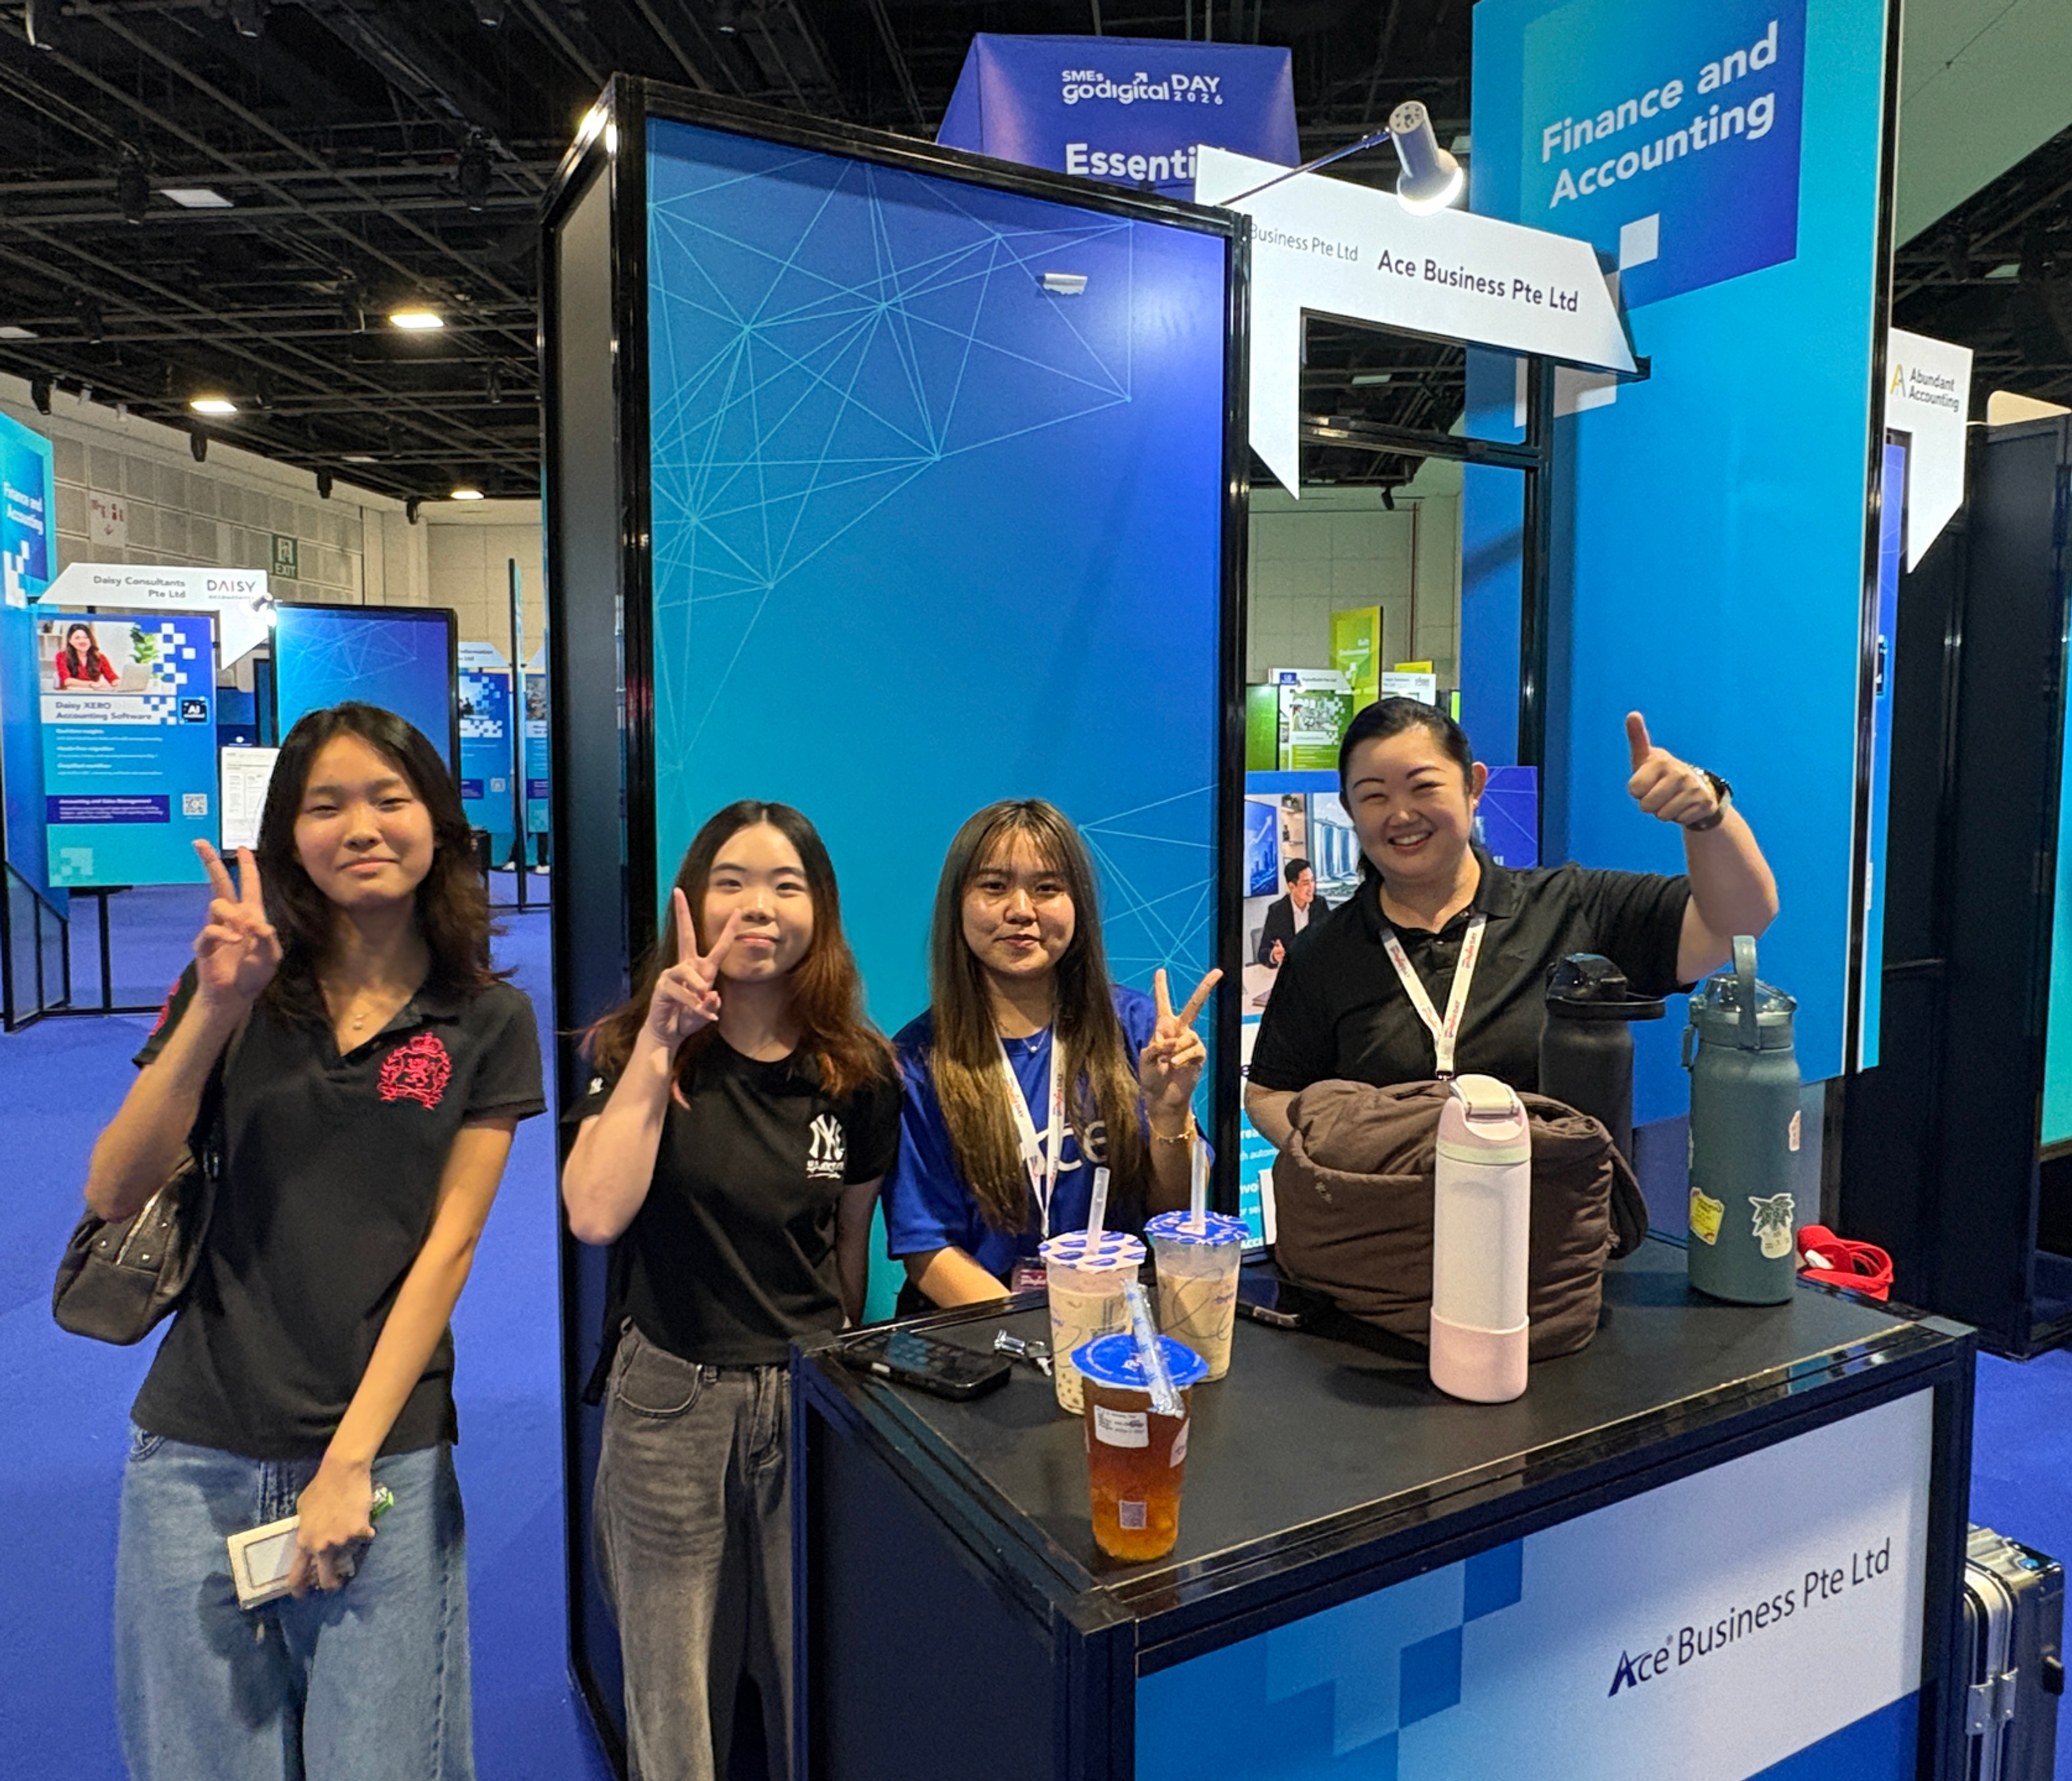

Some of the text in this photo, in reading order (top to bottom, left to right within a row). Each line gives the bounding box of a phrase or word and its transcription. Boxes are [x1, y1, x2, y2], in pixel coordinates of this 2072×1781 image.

[1062, 70, 1103, 82] SMEs
[1171, 74, 1220, 93] DAY
[1173, 91, 1223, 105] 2026
[1542, 20, 1778, 163] Finance and
[1549, 93, 1775, 209] Accounting
[1066, 143, 1197, 182] Essenti
[1250, 223, 1358, 262] Business Pte Ltd
[1378, 250, 1579, 312] Ace Business Pte Ltd
[1910, 368, 1955, 392] Abundant
[1908, 385, 1959, 413] Accounting
[275, 563, 296, 577] EXIT
[93, 575, 186, 587] Daisy Consultants
[207, 580, 256, 593] DAISY
[148, 590, 166, 598] Pte
[55, 701, 81, 710] Daisy
[1678, 1589, 1795, 1666] Business
[1803, 1568, 1844, 1608] Pte
[1852, 1537, 1890, 1587] Ltd
